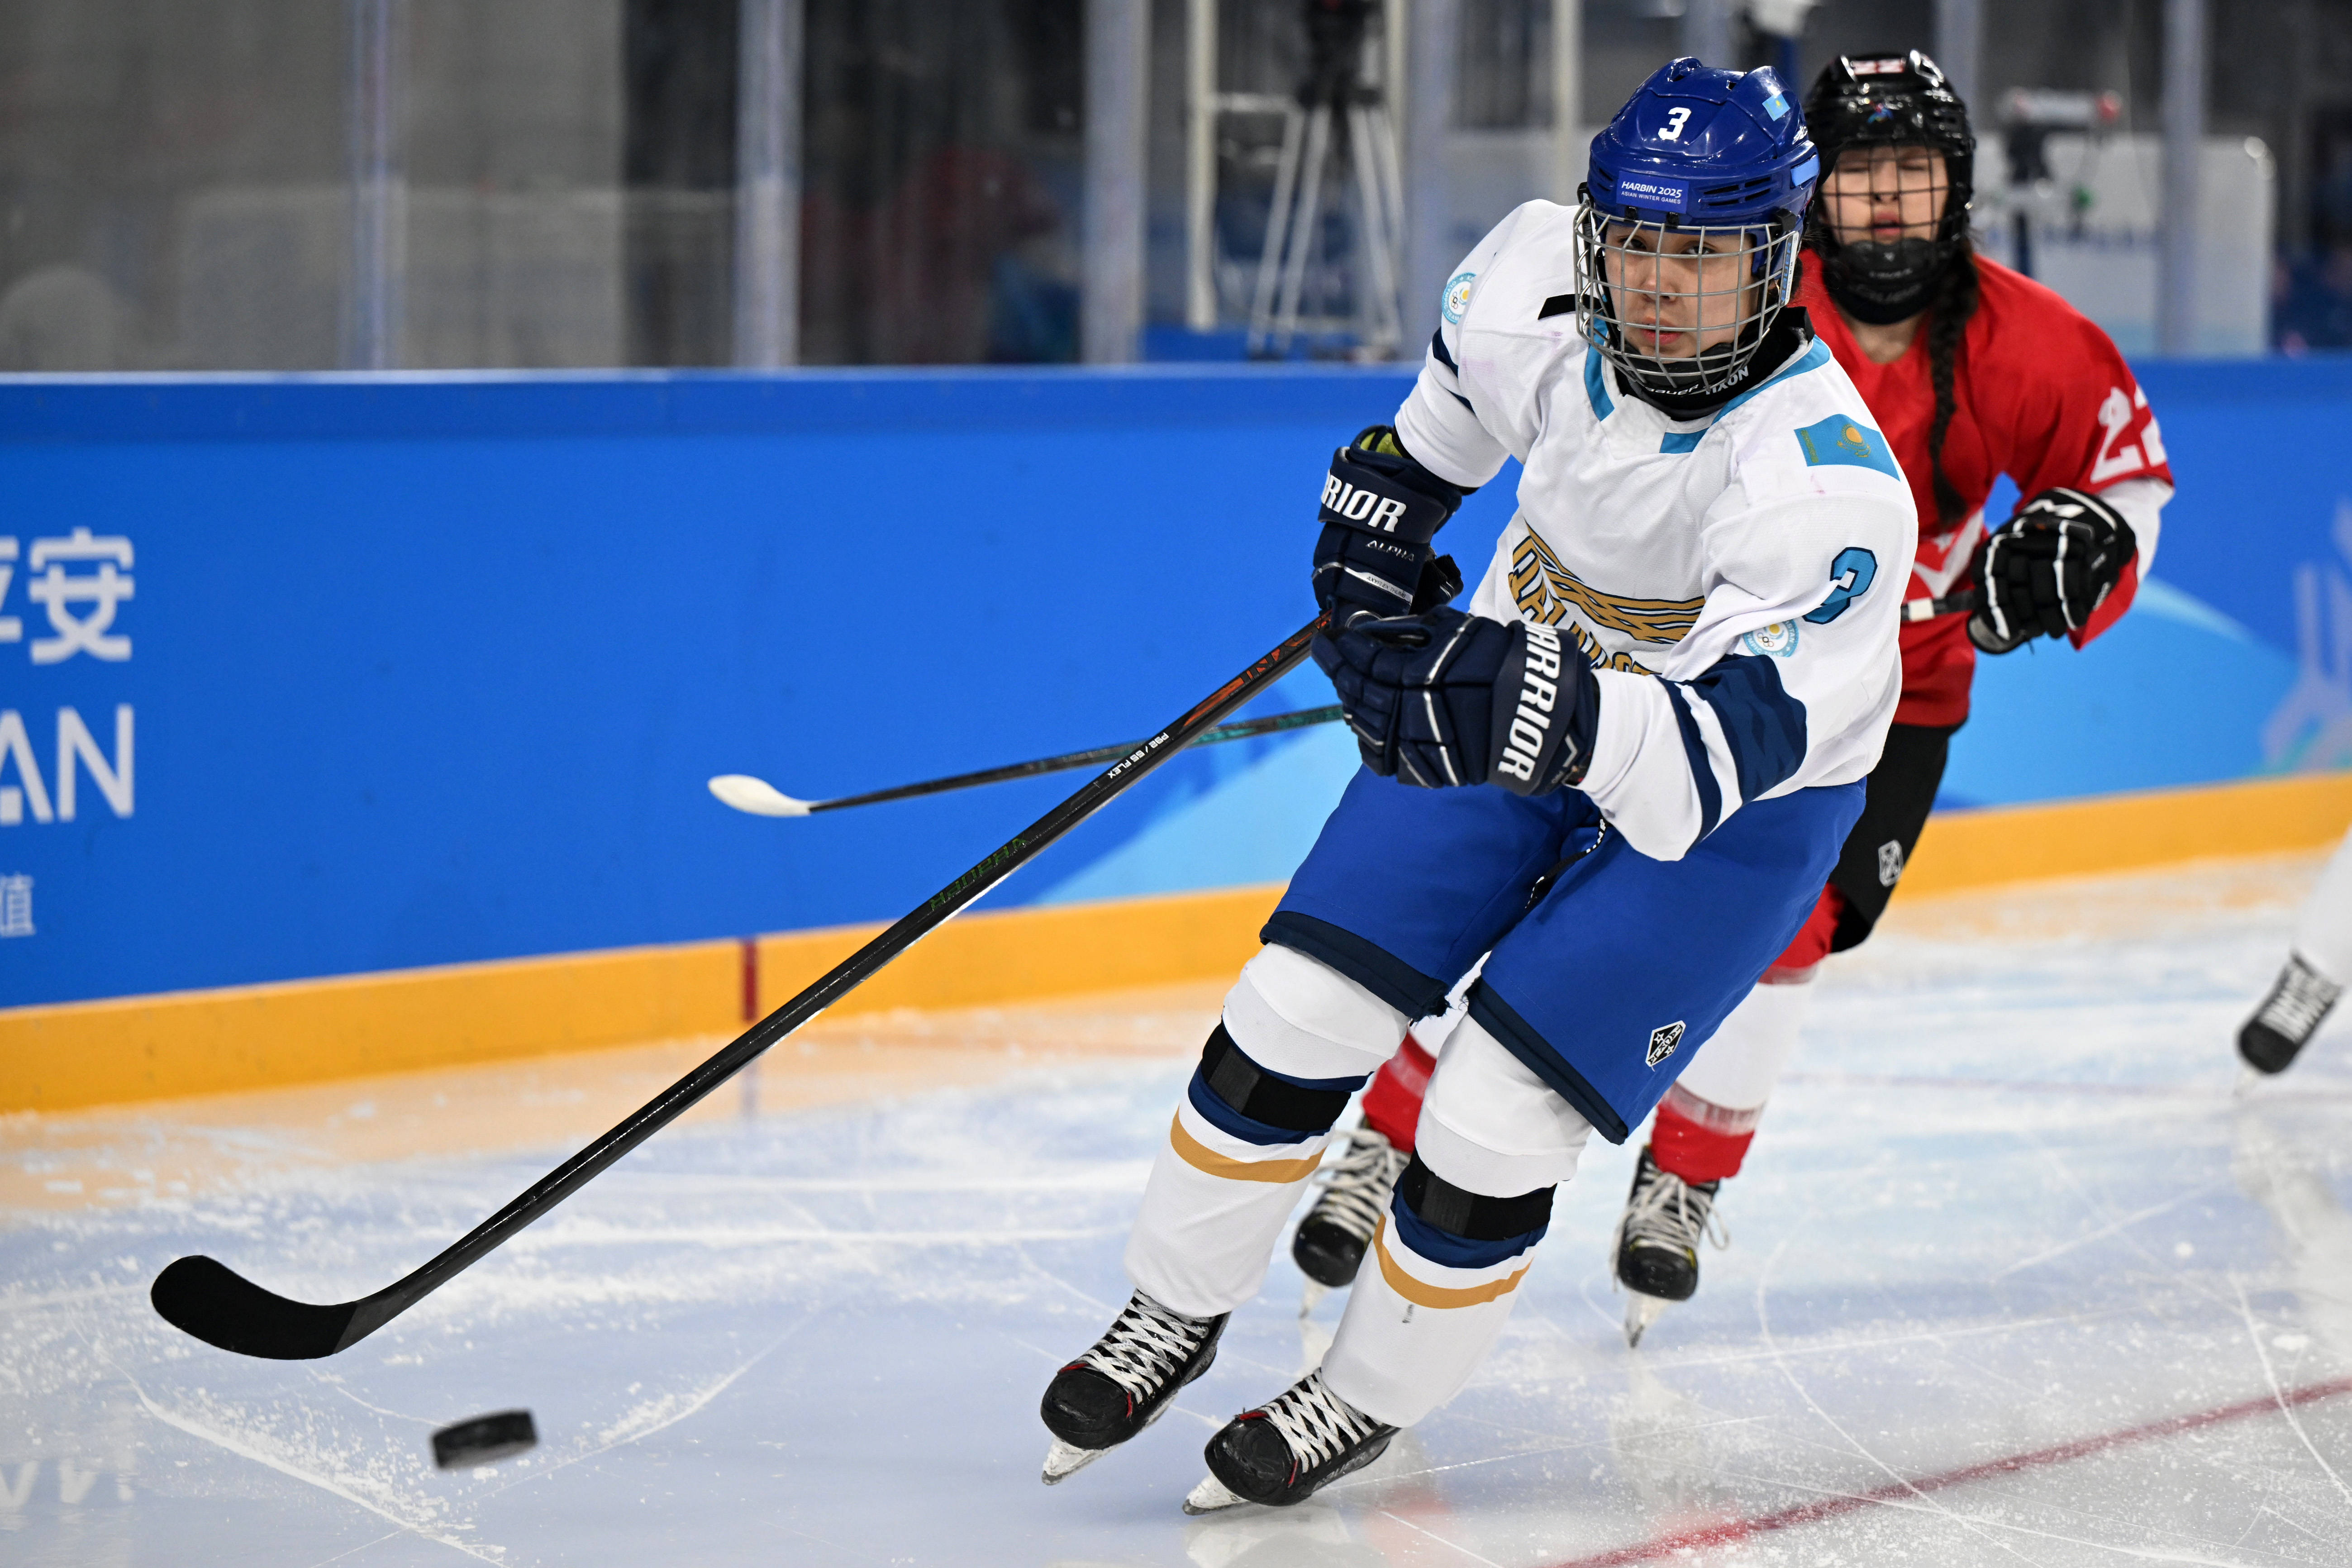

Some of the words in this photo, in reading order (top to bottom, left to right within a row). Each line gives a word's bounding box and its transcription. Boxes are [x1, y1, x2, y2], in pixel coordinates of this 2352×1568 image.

[1658, 107, 1691, 140] 3
[1621, 181, 1657, 194] HARBIN
[1657, 187, 1683, 198] 2025
[1320, 468, 1407, 533] RIOR
[1366, 540, 1415, 562] ALPHA
[0, 525, 135, 664] 安
[1148, 732, 1170, 748] P92
[1107, 759, 1132, 779] FLEX
